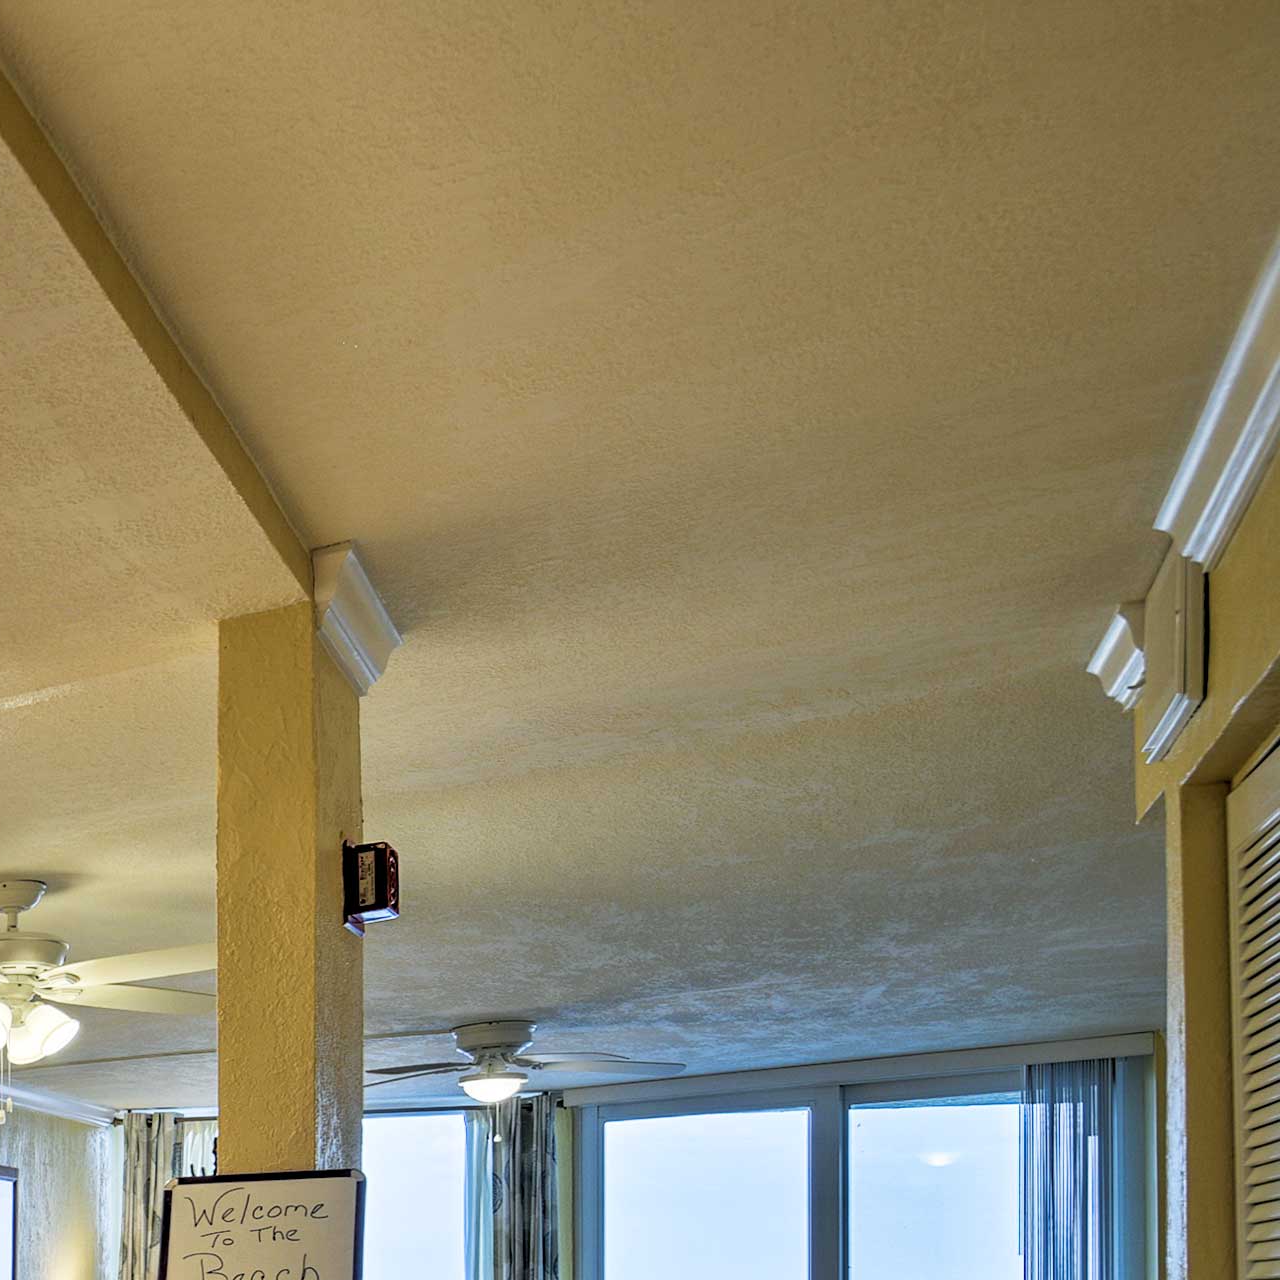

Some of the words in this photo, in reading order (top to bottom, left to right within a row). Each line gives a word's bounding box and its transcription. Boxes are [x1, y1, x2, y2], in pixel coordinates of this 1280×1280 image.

[184, 1186, 328, 1228] Welcome
[200, 1229, 235, 1249] To
[250, 1225, 301, 1243] The
